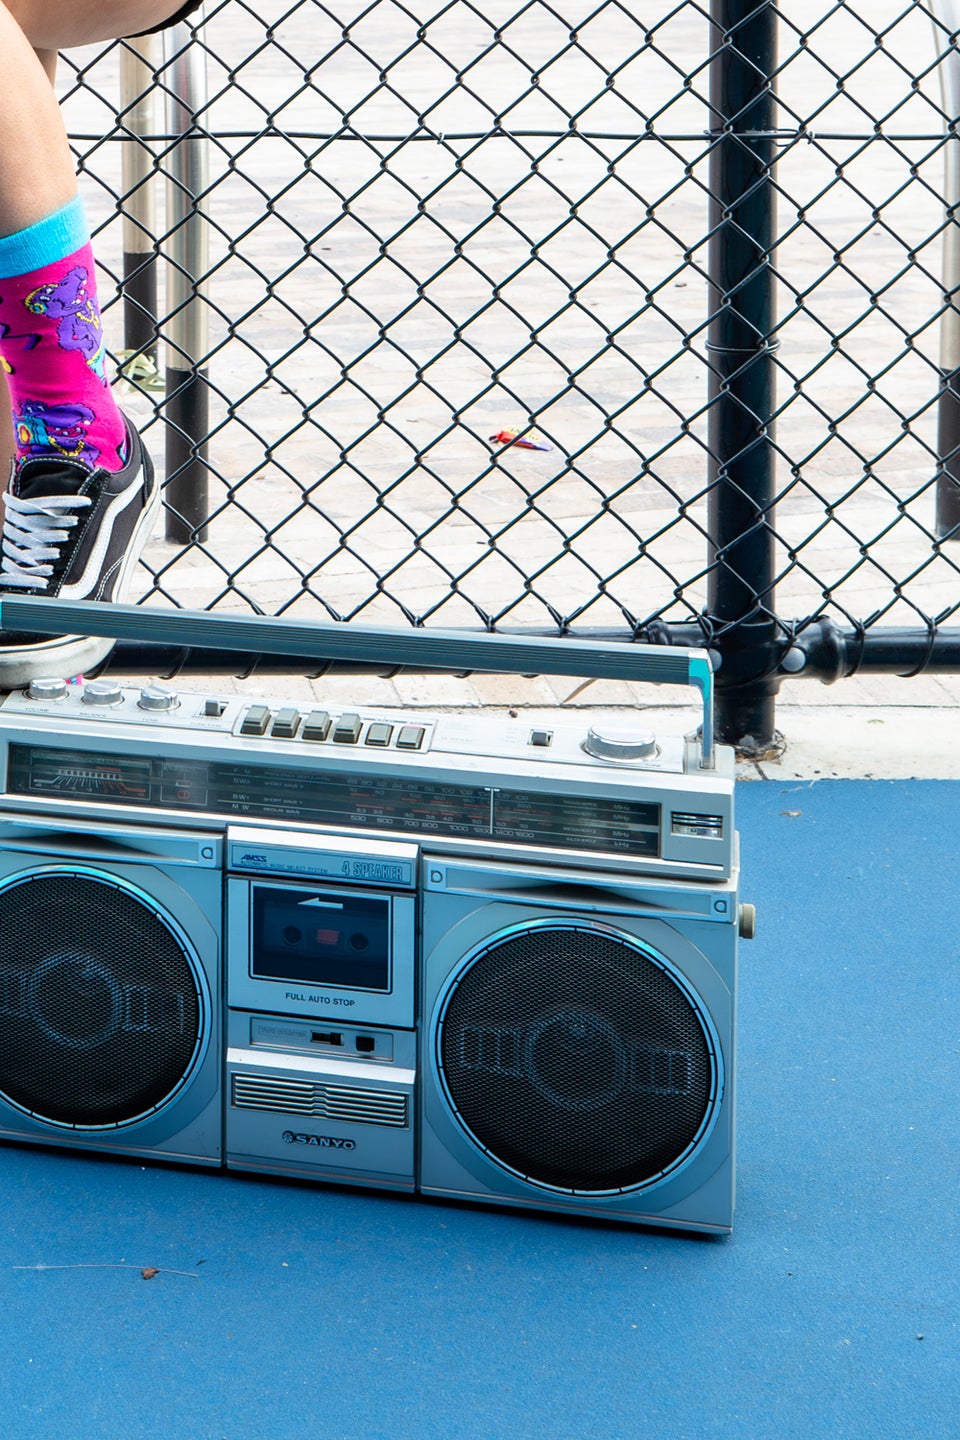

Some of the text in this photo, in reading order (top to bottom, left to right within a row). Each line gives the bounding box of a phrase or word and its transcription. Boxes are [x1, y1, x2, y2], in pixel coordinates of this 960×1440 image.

[241, 854, 268, 863] AMSS
[342, 860, 403, 881] 4 SPEAKER
[285, 992, 355, 1007] FULL AUTO STOP
[295, 1134, 355, 1150] SANYO
